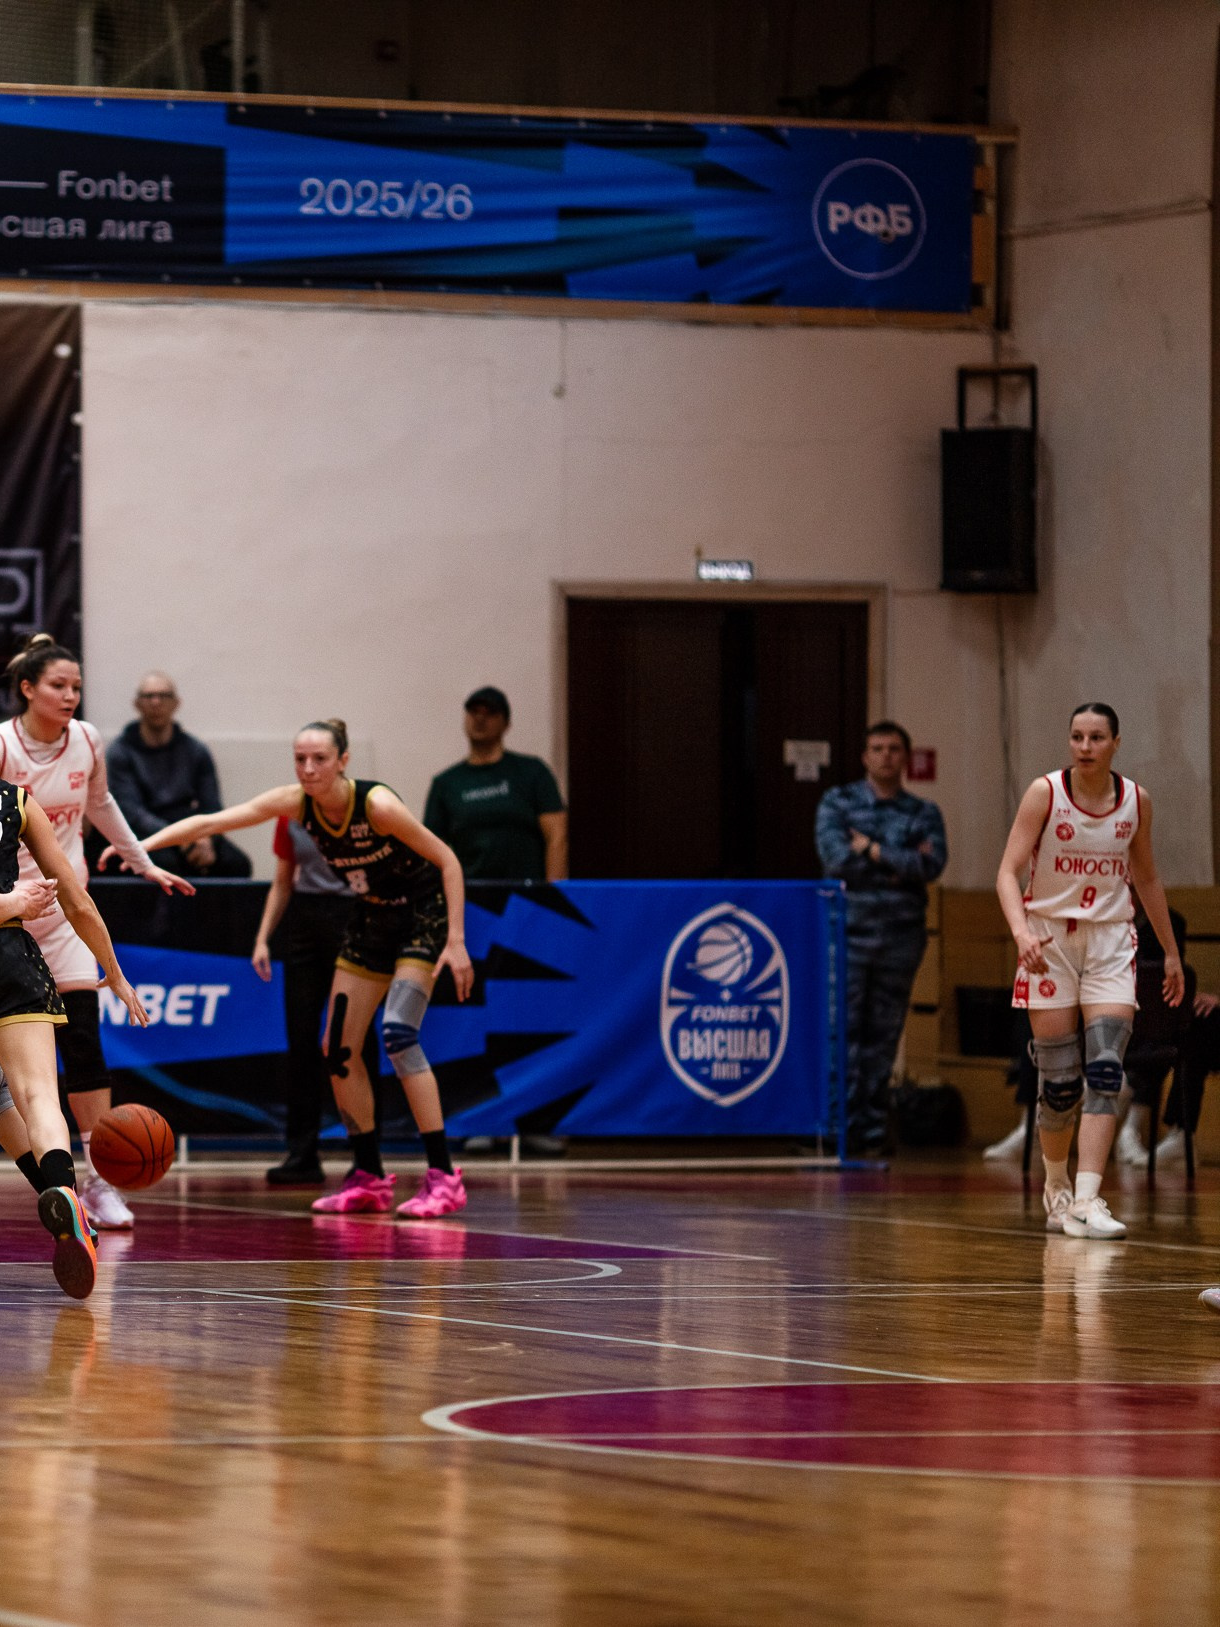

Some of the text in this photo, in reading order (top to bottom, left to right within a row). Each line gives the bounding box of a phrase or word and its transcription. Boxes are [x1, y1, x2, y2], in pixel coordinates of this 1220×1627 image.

[57, 170, 174, 201] Fonbet
[299, 178, 474, 221] 2025/26
[96, 217, 174, 243] лига
[828, 202, 913, 236] РФБ
[1054, 855, 1125, 877] ЮНОСТЬ
[1080, 886, 1097, 909] 9
[99, 984, 230, 1026] NBET
[690, 1005, 762, 1022] FONBET
[677, 1029, 770, 1060] ВЫСШАЯ
